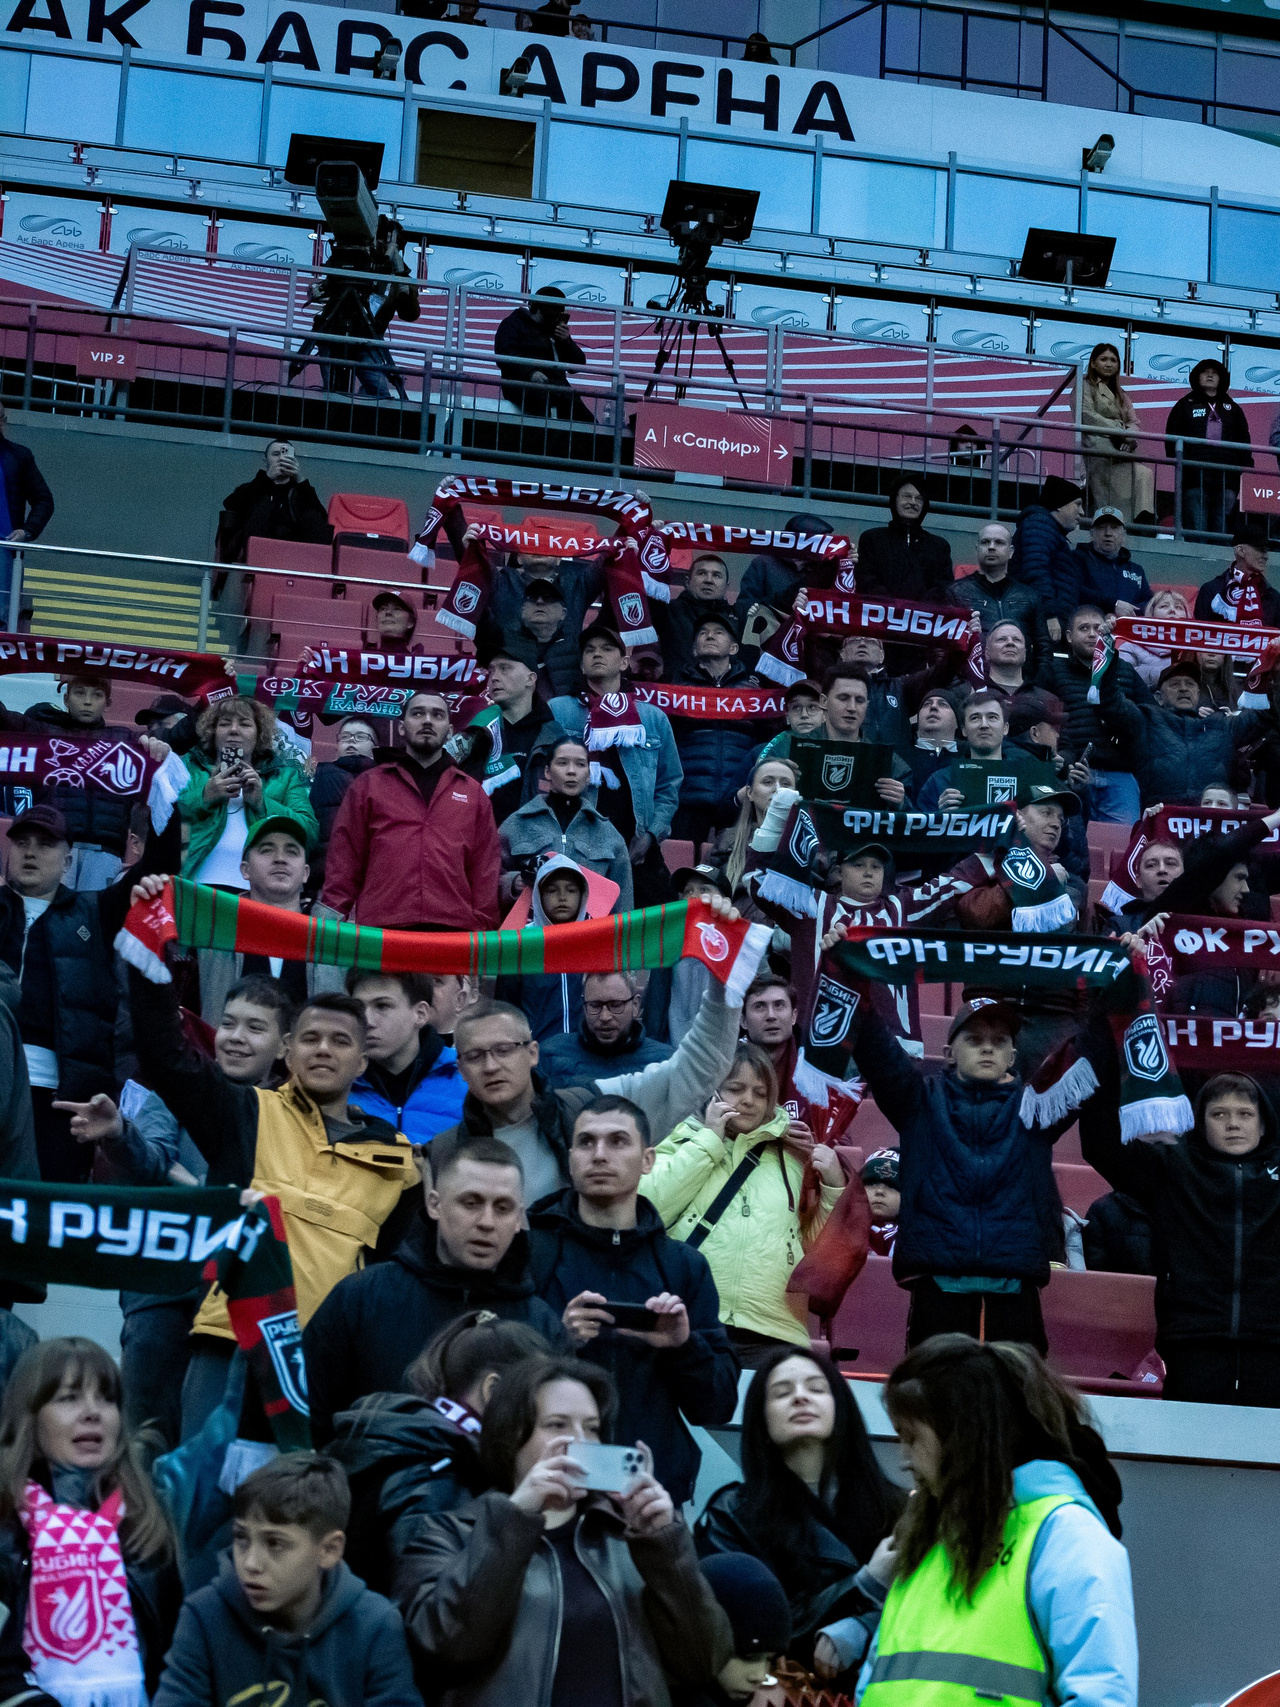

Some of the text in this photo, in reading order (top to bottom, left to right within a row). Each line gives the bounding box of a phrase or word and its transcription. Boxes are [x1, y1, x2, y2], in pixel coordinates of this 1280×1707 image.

[512, 43, 855, 142] АРЕНА
[31, 236, 55, 248] Барс
[56, 239, 85, 251] Арена
[90, 351, 125, 365] VIP 2
[673, 432, 761, 457] «Сапфир»
[1253, 488, 1274, 499] VIP
[724, 526, 847, 554] РУБИН
[57, 643, 190, 679] РУБИН
[263, 677, 328, 698] ФК
[331, 701, 402, 717] КАЗАНЬ
[904, 813, 1014, 838] РУБИН
[1174, 927, 1230, 954] ФК
[820, 977, 857, 1005] РУБИН
[48, 1201, 268, 1263] РУБИН
